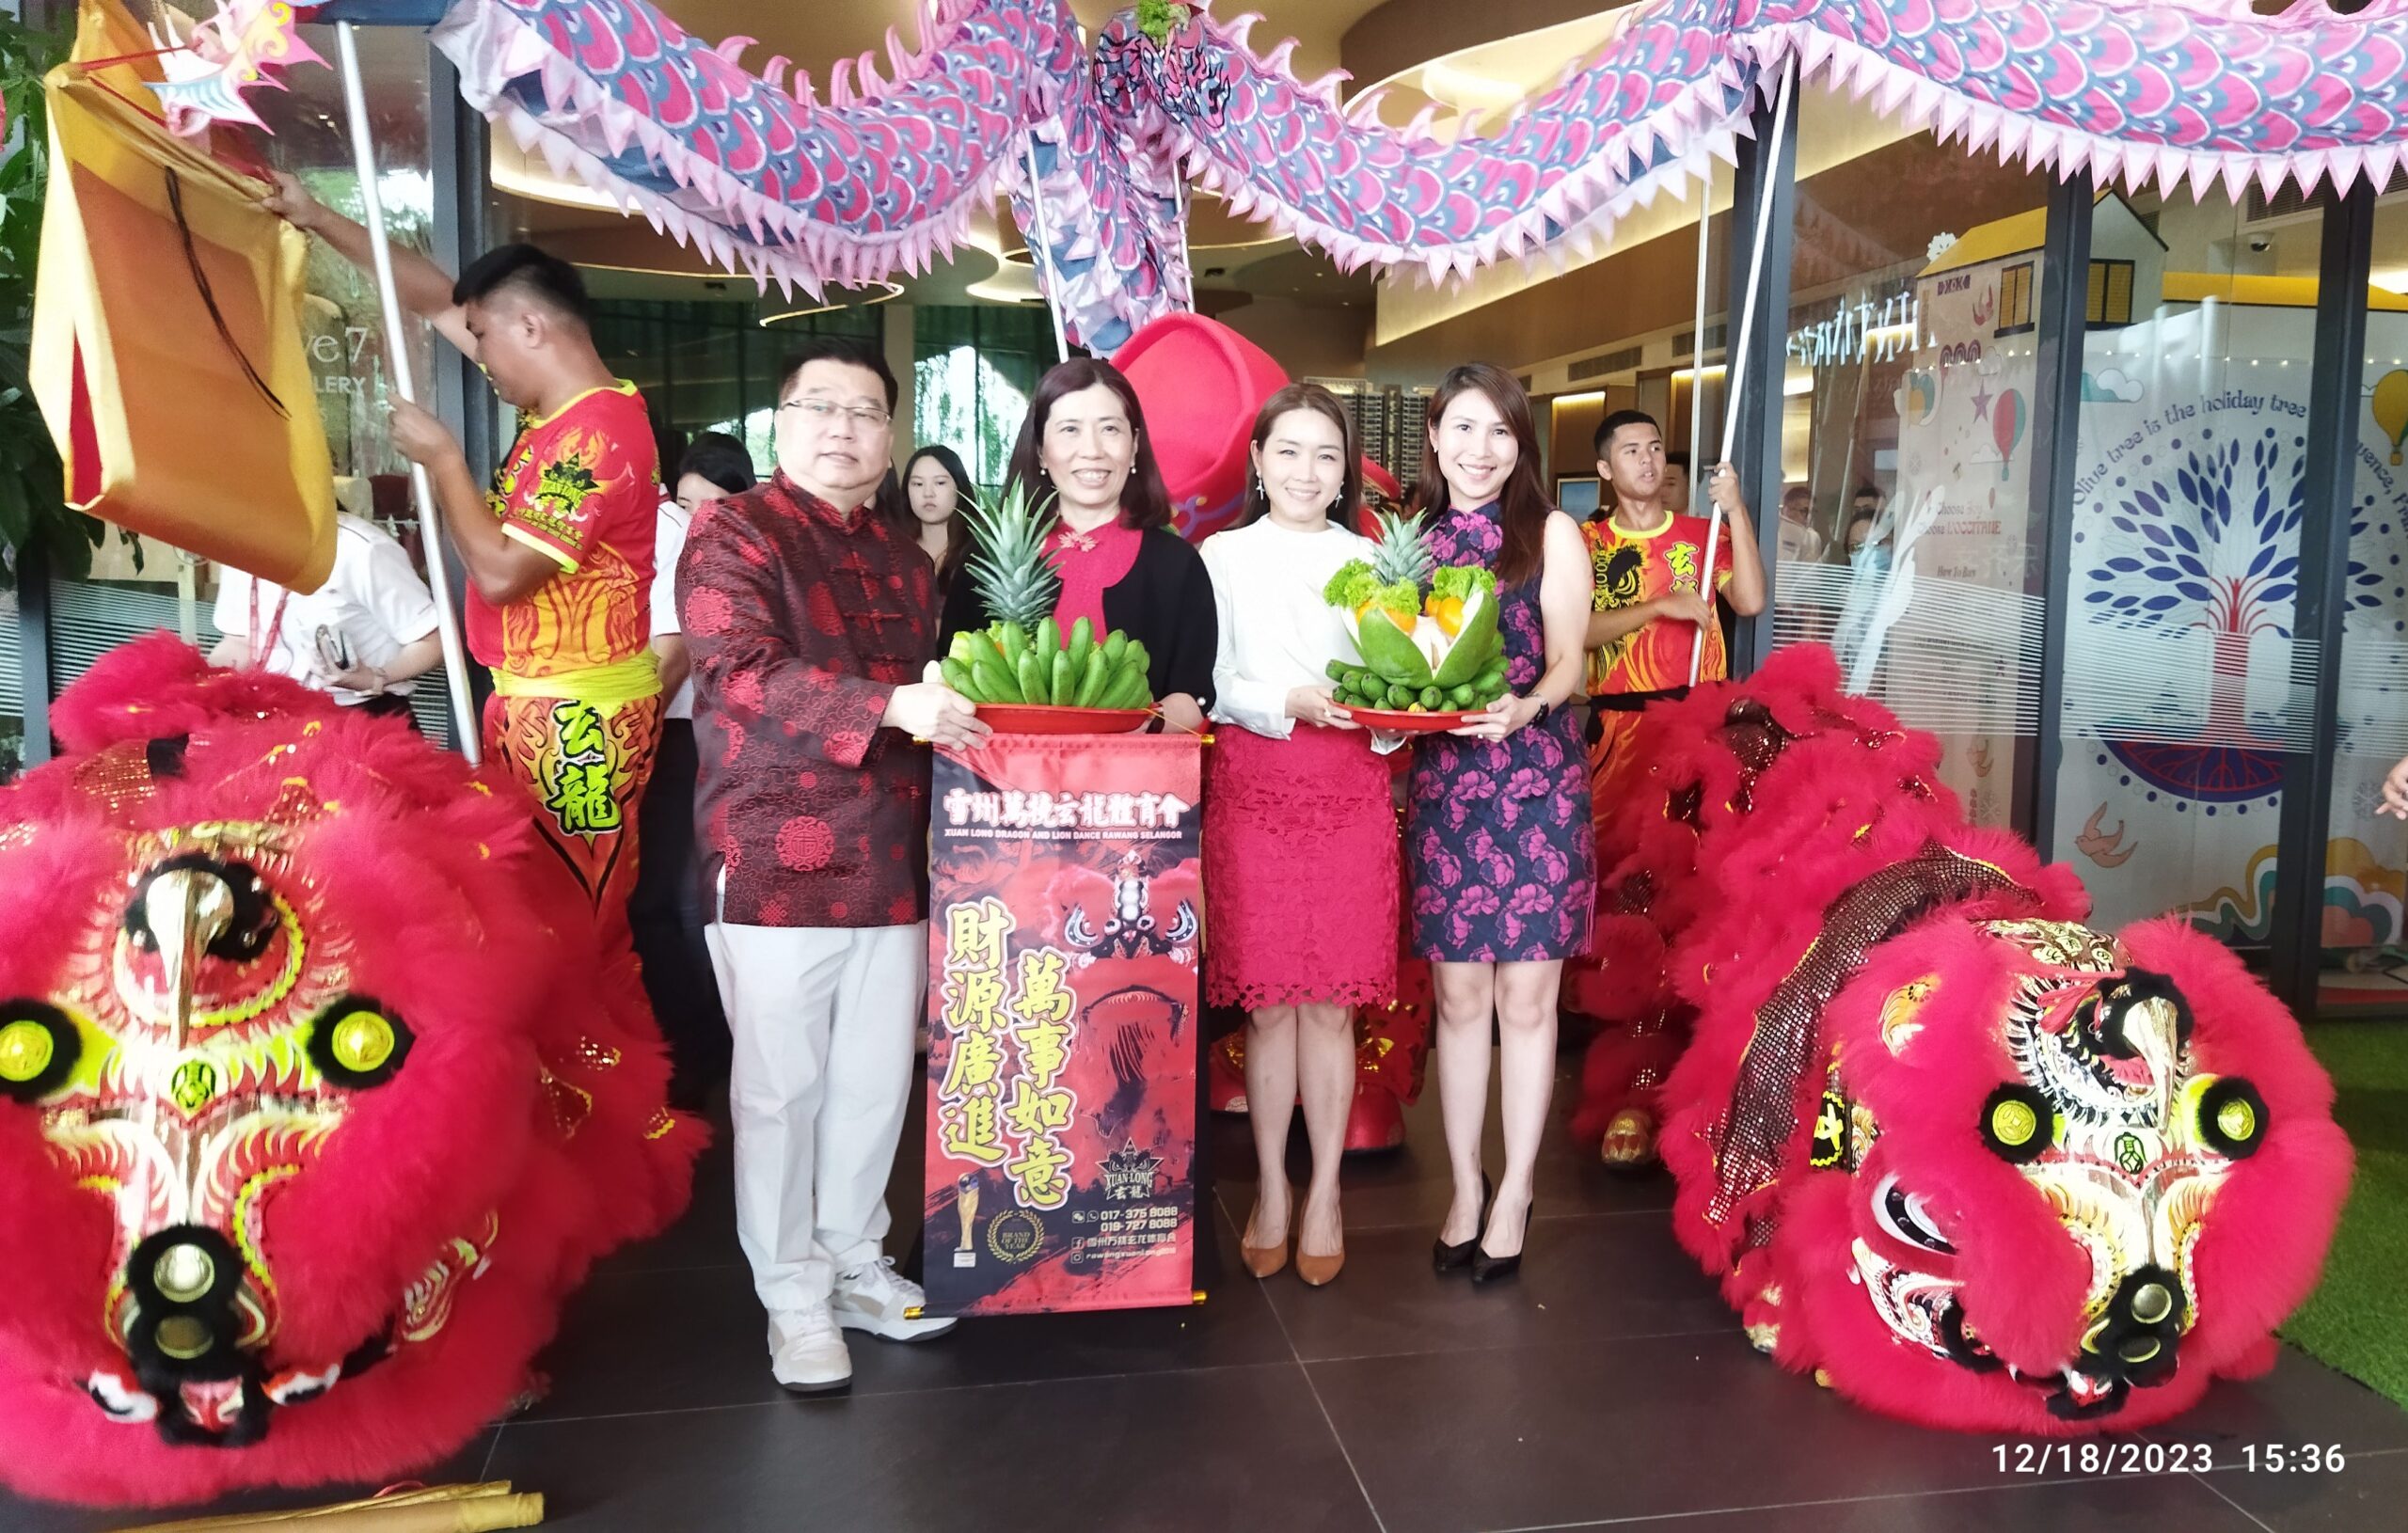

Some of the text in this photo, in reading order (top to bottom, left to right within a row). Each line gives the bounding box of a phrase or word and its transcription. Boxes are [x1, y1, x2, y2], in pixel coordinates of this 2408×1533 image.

[315, 376, 367, 394] LERY
[2073, 389, 2306, 505] Olive tree is the holiday tree
[1664, 542, 1699, 593] 玄
[944, 829, 1182, 840] XUAN LONG DRAGON AND LION DANCE RAWANG SELANGOR
[940, 897, 1014, 1164] 財源廣進
[1004, 948, 1074, 1208] 萬事如意
[1130, 1172, 1154, 1188] LONG
[1149, 1207, 1179, 1218] 8088
[1149, 1218, 1178, 1230] 8088
